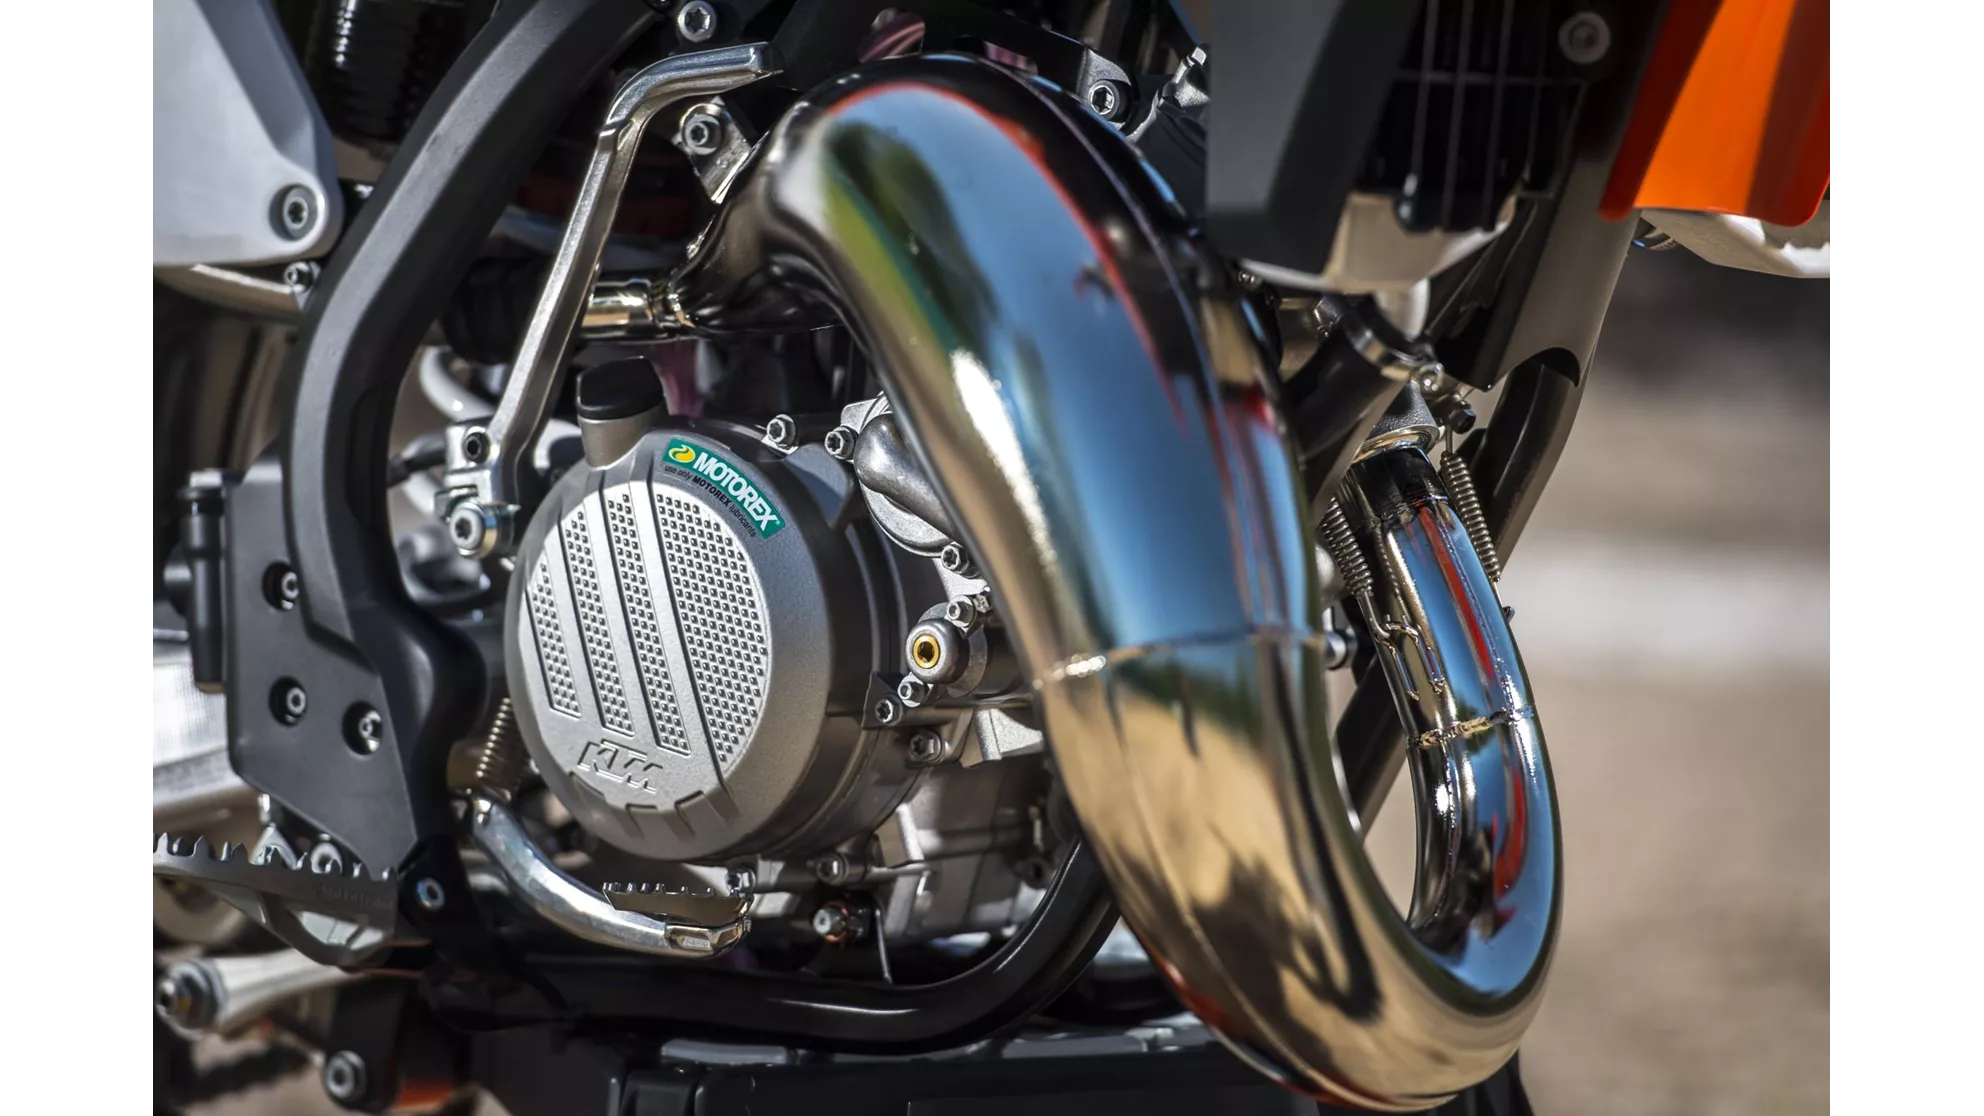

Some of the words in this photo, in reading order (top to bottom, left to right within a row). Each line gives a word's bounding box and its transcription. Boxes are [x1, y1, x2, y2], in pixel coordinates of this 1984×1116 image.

[664, 465, 677, 474] use
[677, 470, 693, 480] only
[692, 475, 731, 507] MOTOREX
[729, 505, 757, 538] lubricants
[692, 452, 778, 531] MOTOREX
[577, 738, 663, 794] KTM
